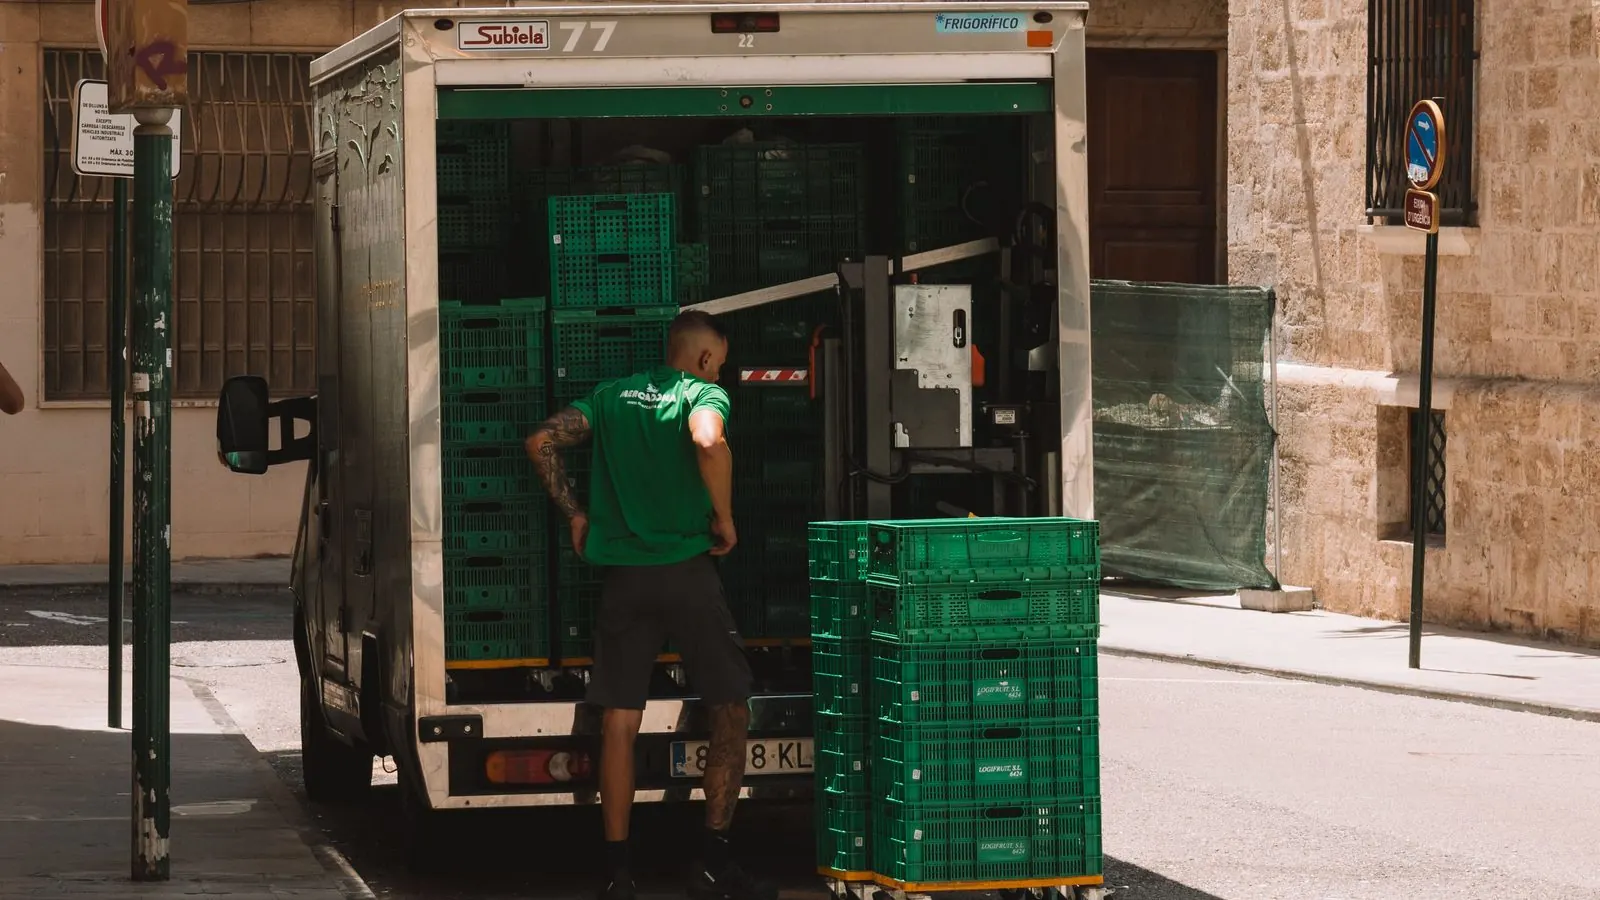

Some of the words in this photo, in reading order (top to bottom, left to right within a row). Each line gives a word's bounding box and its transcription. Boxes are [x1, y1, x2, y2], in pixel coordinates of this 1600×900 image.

[944, 14, 1019, 30] FRIGORÍFICO
[464, 25, 544, 45] Subiela
[559, 20, 618, 53] 77
[738, 33, 754, 48] 22
[695, 743, 767, 770] 88
[778, 742, 813, 769] KL
